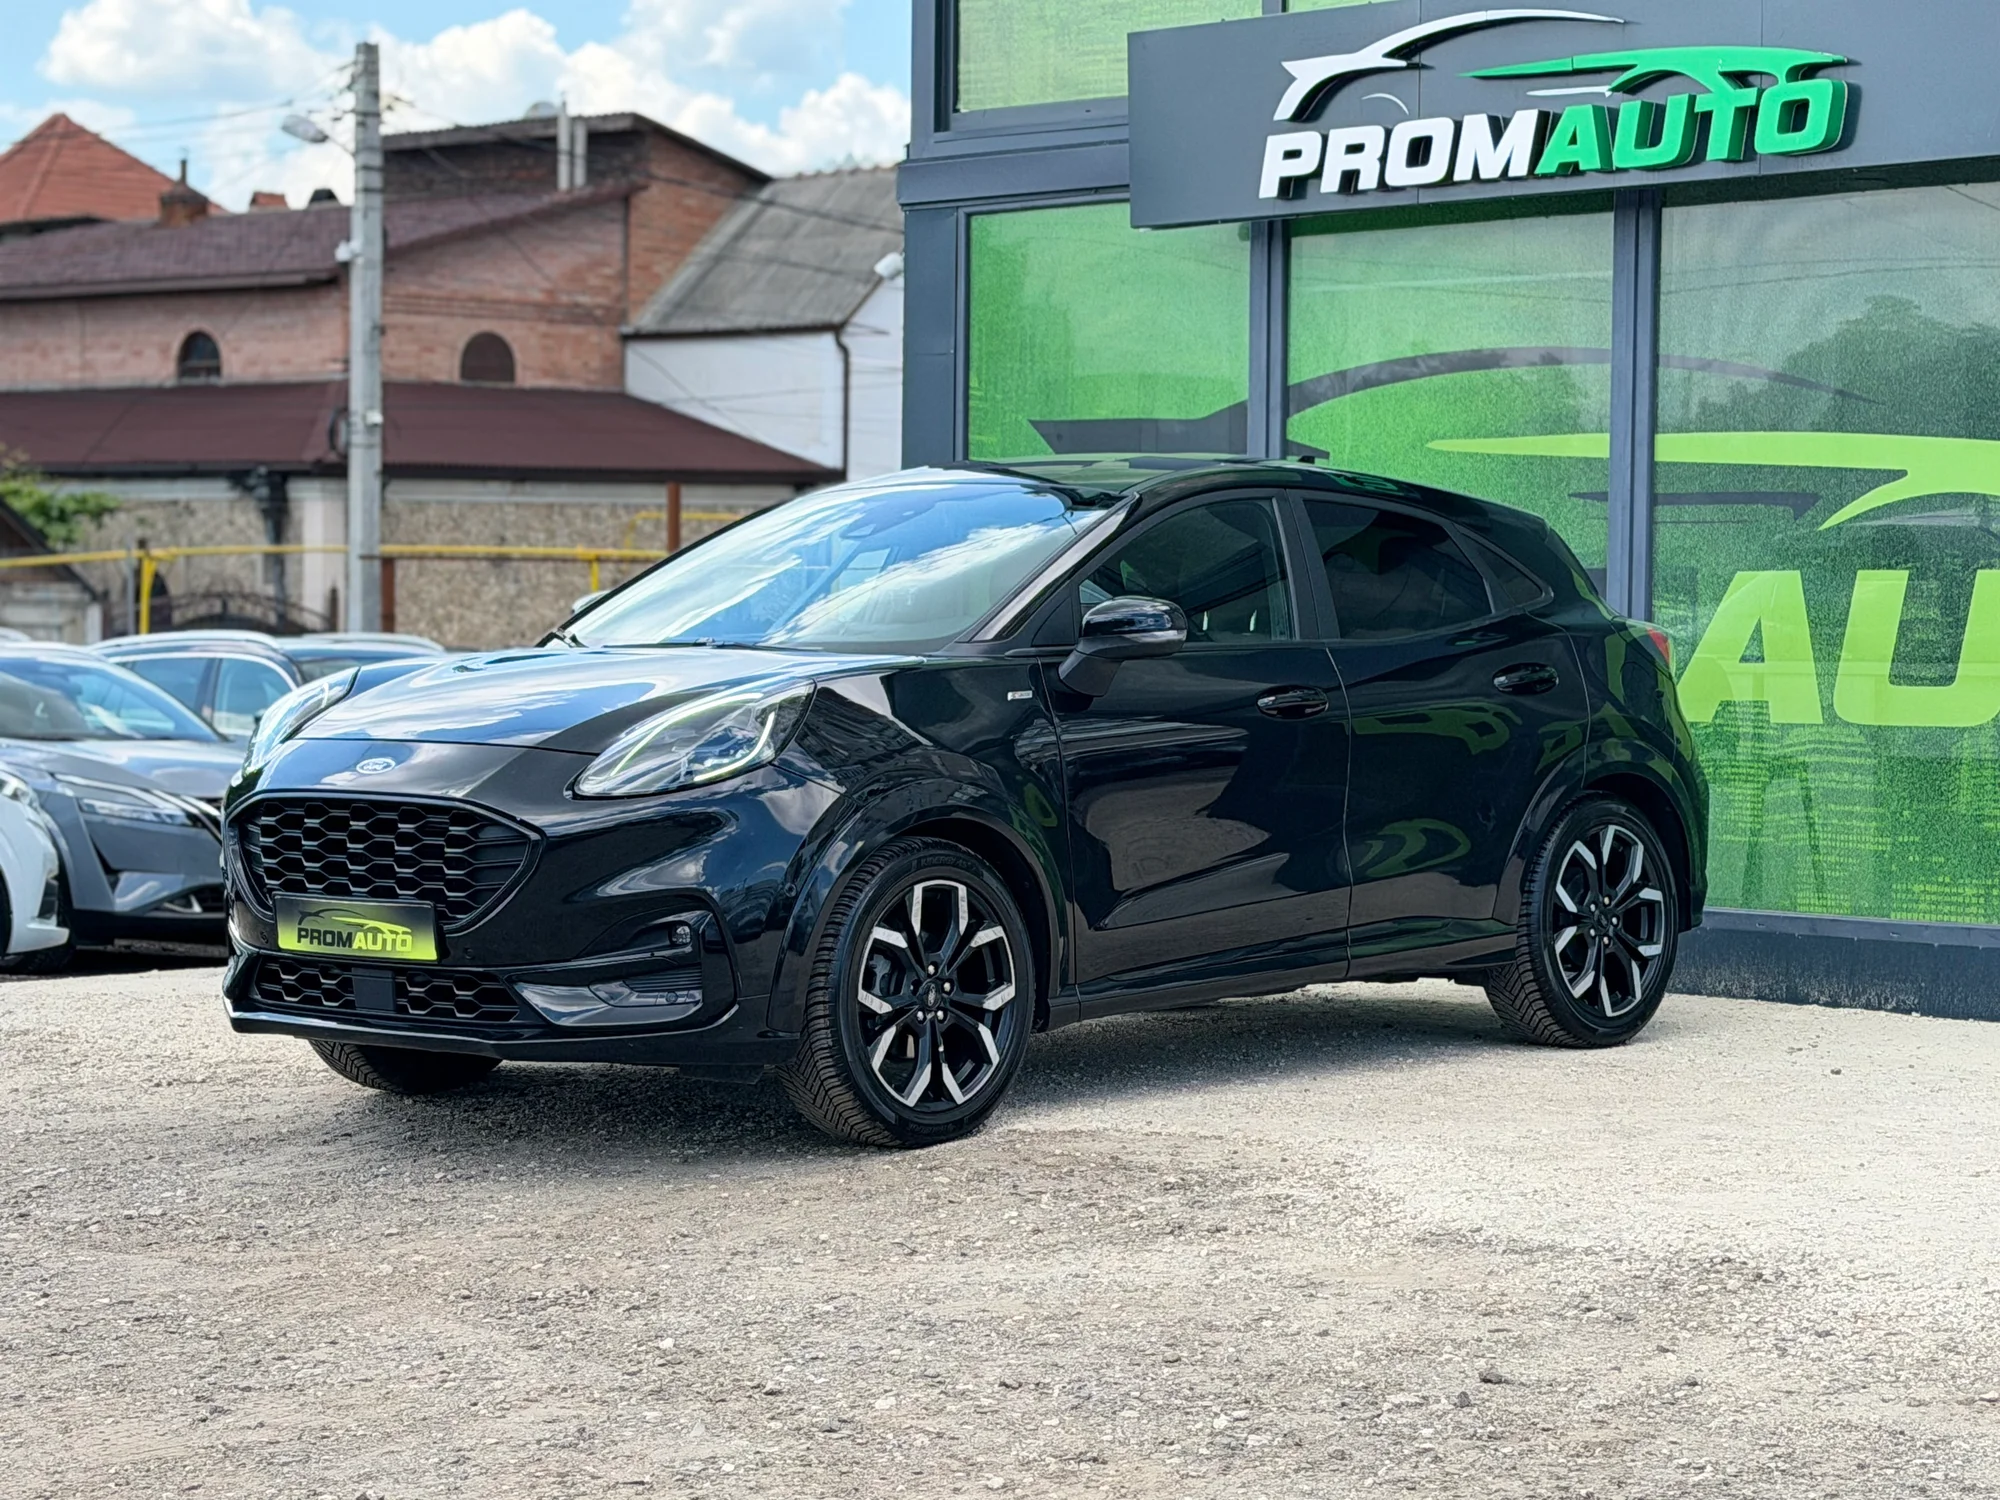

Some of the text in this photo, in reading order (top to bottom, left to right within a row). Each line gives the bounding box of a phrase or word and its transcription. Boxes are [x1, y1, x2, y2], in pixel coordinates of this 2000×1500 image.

[1258, 79, 1849, 199] PROMAUTO
[1676, 569, 2000, 728] AU
[296, 927, 413, 952] PROMAUTO
